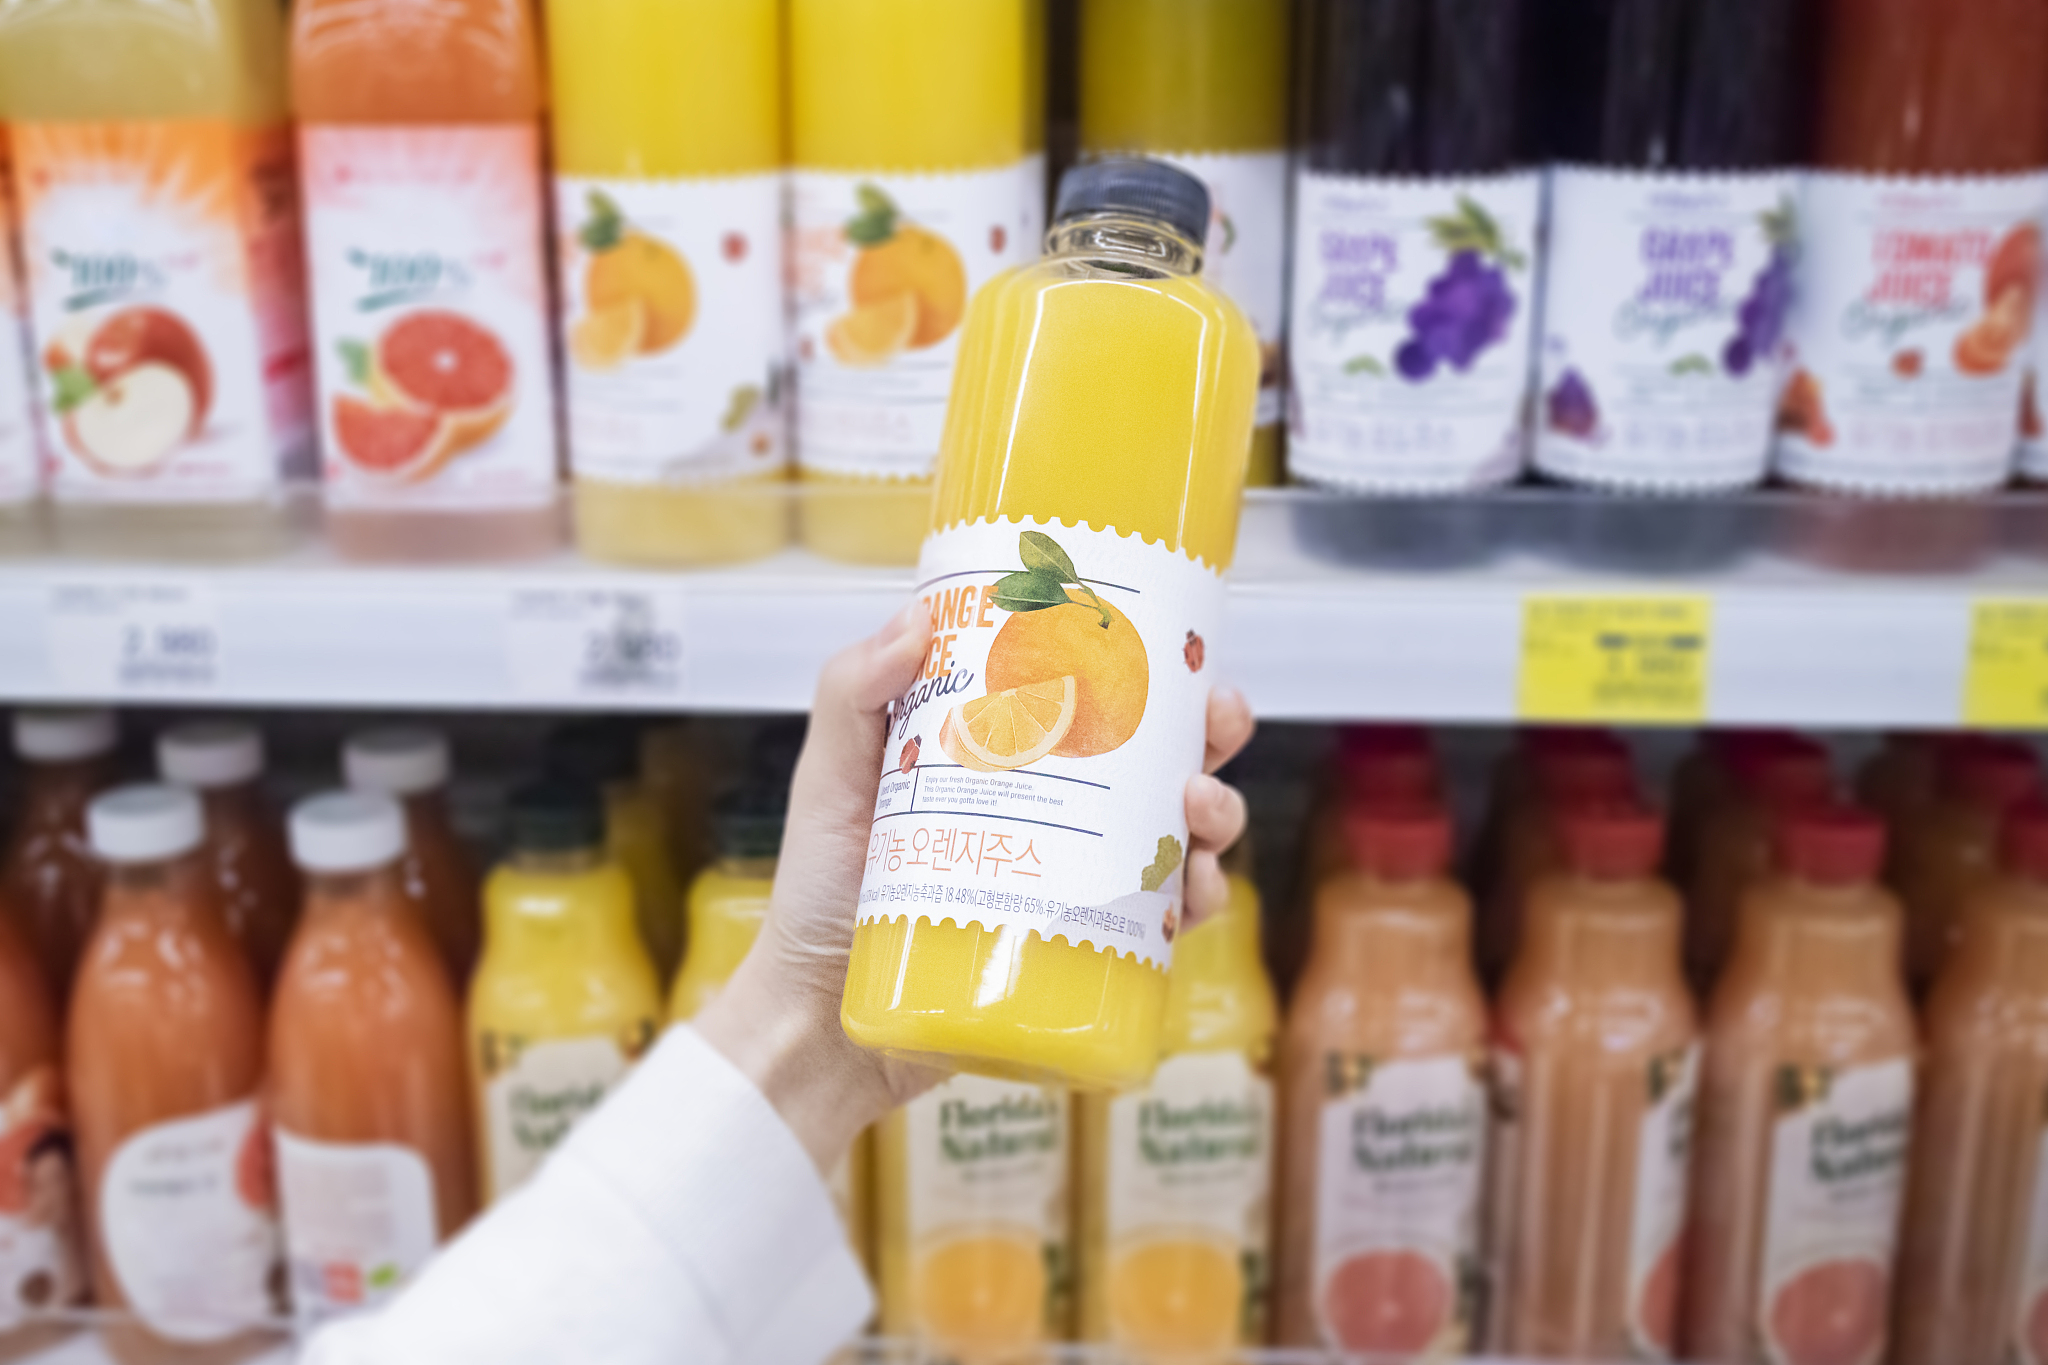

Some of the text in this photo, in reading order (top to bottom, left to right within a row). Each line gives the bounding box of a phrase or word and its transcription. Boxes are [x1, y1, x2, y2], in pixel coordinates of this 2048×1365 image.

[925, 775, 938, 784] Enjoy
[949, 776, 964, 784] fresh
[965, 777, 989, 787] Organic
[990, 778, 1014, 789] Orange
[922, 795, 935, 803] taste
[947, 796, 958, 804] you
[959, 796, 975, 805] gotta
[976, 798, 989, 806] love
[924, 785, 1064, 806] This Organic Orange Juice will present the best
